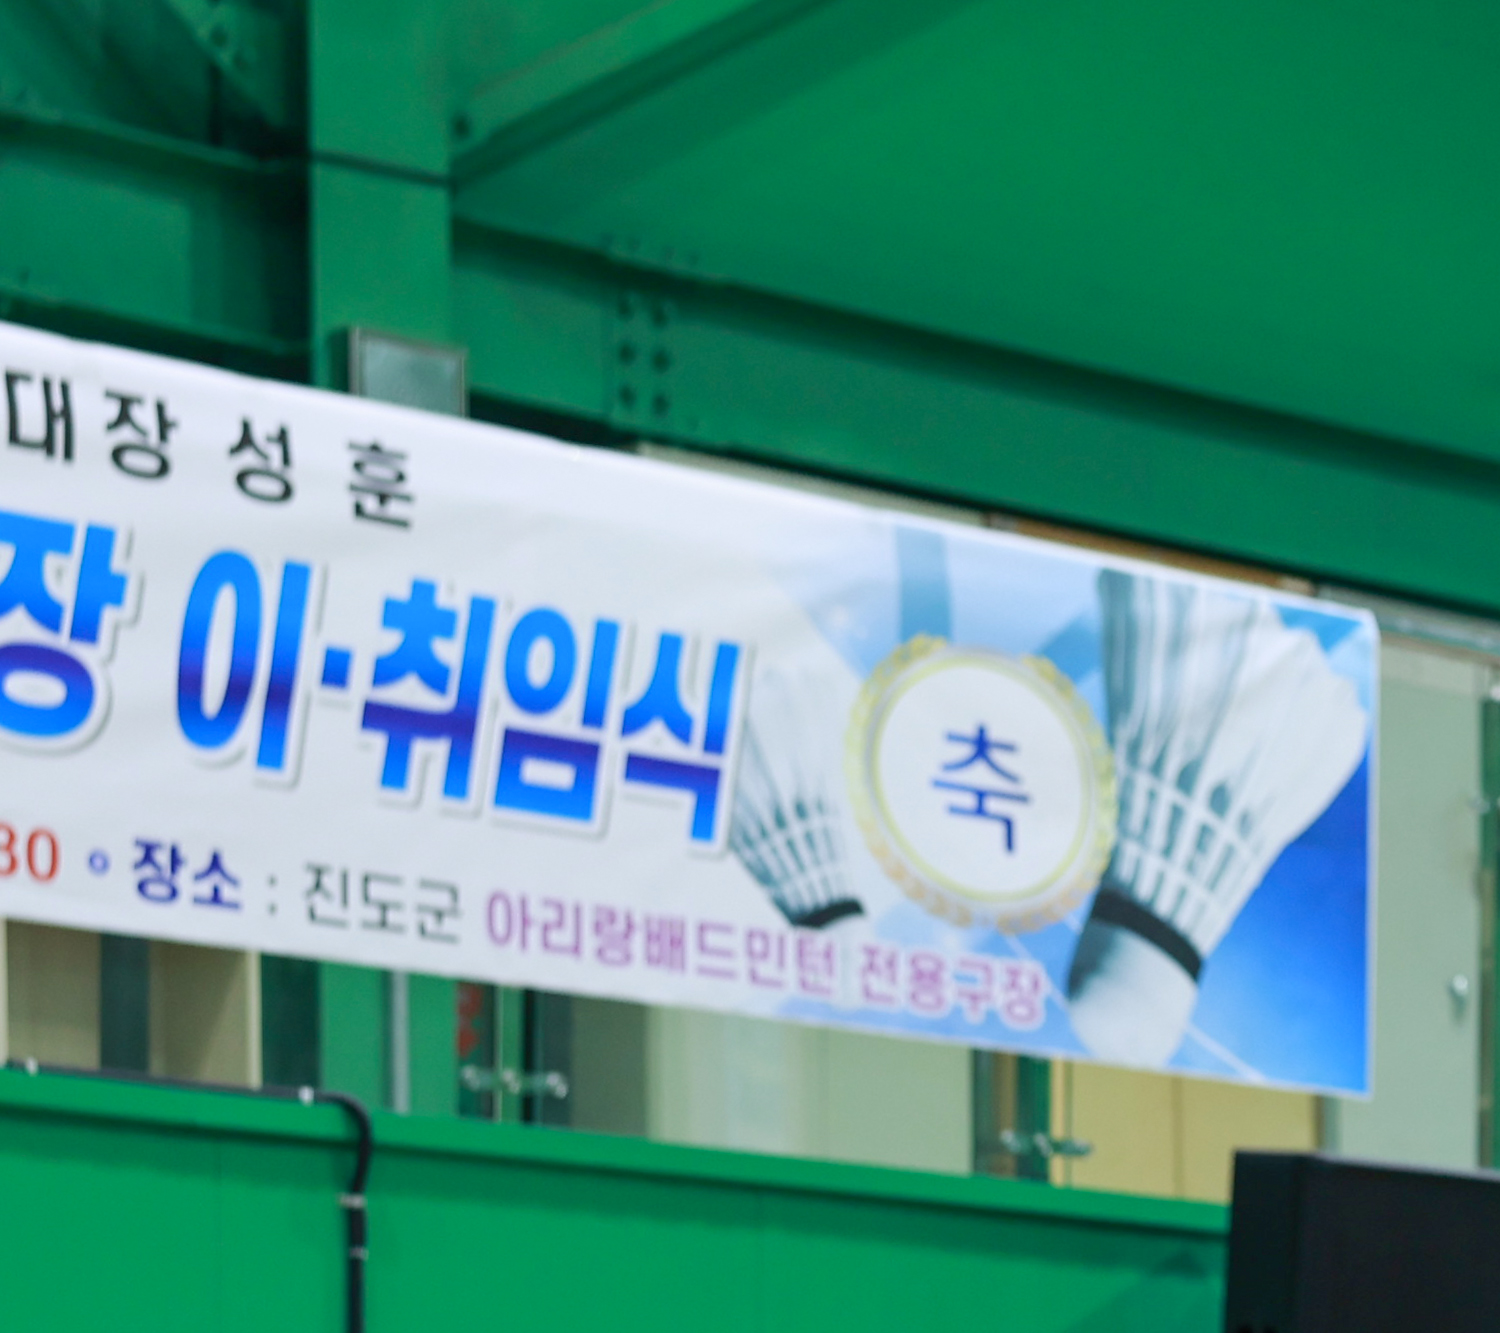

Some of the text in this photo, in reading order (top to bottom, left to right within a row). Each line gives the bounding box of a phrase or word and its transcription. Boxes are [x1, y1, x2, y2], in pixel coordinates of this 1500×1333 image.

[931, 724, 1032, 854] 축
[132, 836, 243, 911] 장소
[304, 862, 461, 944] 진도군
[860, 942, 1047, 1027] 전용구장
